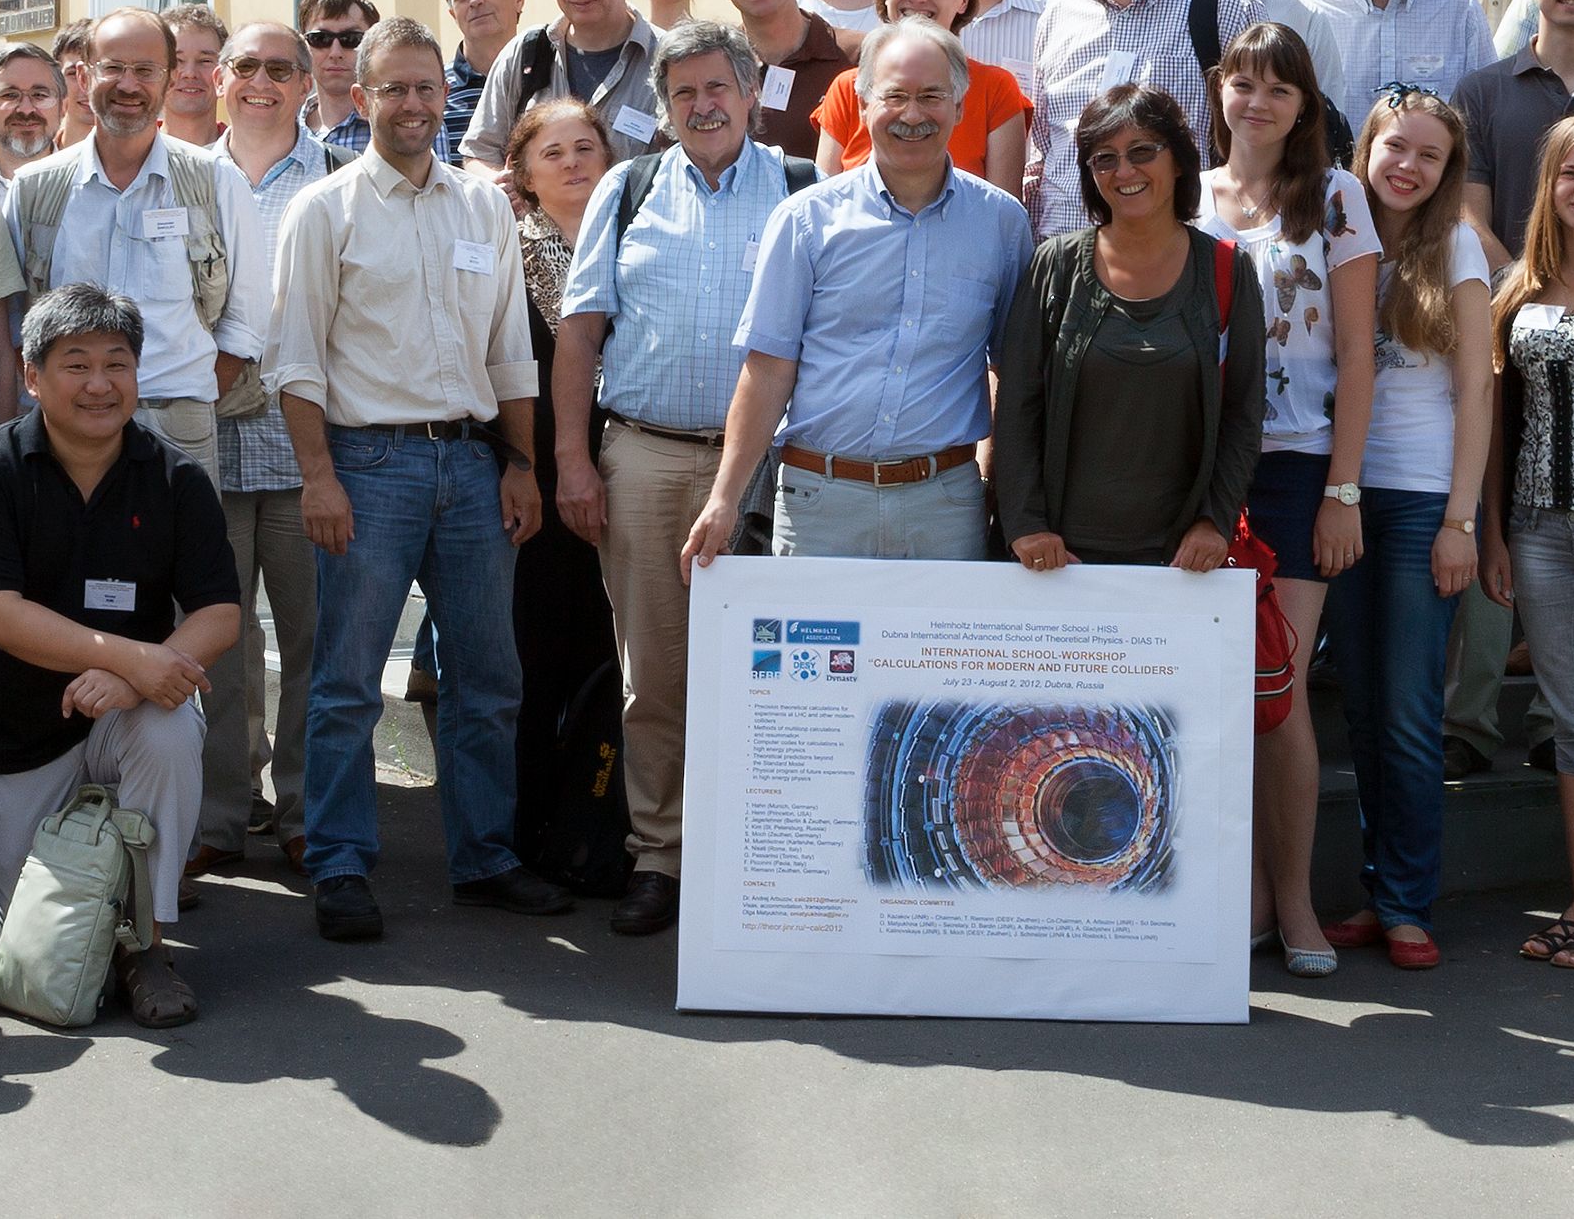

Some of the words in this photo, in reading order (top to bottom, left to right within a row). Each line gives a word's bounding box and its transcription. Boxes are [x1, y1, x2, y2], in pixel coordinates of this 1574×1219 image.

[973, 623, 1023, 631] International
[1061, 624, 1089, 632] School
[1097, 625, 1118, 633] HISS
[881, 630, 909, 638] Dubna
[911, 631, 961, 640] International
[962, 632, 1003, 641] Advanced
[1005, 633, 1032, 641] School
[1035, 634, 1043, 642] of
[1045, 635, 1090, 643] Theoretical
[1092, 636, 1123, 646] Physics
[1131, 637, 1152, 645] DIAS
[1154, 637, 1167, 645] TH
[921, 647, 1008, 658] INTERNATIONAL
[1011, 650, 1127, 661] SCHOOL-WORKSHOP
[961, 661, 984, 670] FOR
[987, 662, 1035, 671] MODERN
[1037, 663, 1061, 672] AND
[1064, 664, 1108, 673] FUTURE
[826, 674, 858, 683] Dynasty
[943, 678, 960, 688] July
[979, 679, 1008, 689] August
[1010, 680, 1017, 688] 2,
[1020, 680, 1042, 689] 2012,
[1044, 681, 1074, 690] Dubna,
[1076, 681, 1104, 689] Russia
